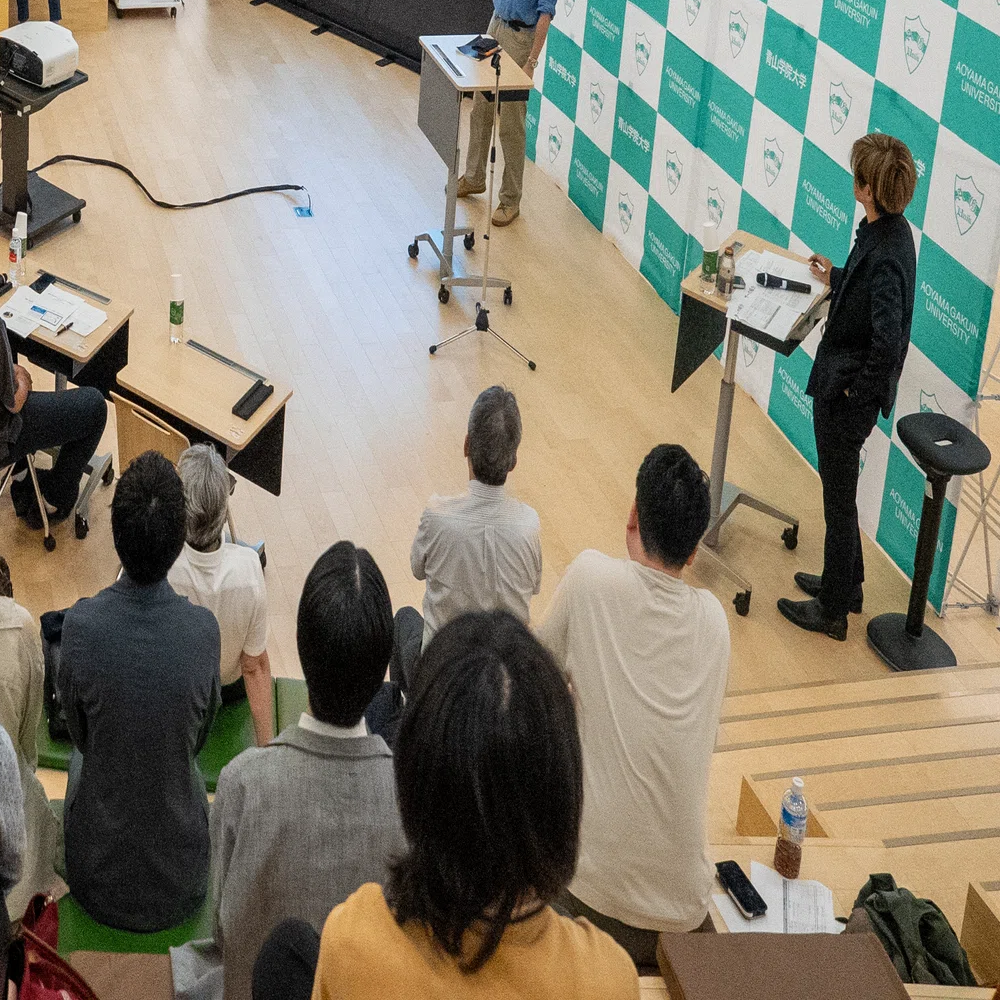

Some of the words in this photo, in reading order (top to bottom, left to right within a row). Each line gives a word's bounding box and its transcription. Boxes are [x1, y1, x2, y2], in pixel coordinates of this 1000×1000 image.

[666, 66, 683, 86] AOYAMA
[683, 80, 701, 102] GAKUIN
[766, 49, 807, 89] 青山学院大学
[955, 61, 987, 89] AOYAMA
[669, 79, 696, 109] UNIVERSITY
[961, 79, 1000, 115] UNIVERSIT
[618, 116, 650, 153] 青山学院大学
[708, 100, 727, 120] AOYAMA
[726, 114, 745, 136] GAKUIN
[711, 113, 739, 142] UNIVERSITY
[802, 179, 825, 204] AOYAMA
[825, 198, 849, 225] GAKUIN
[805, 195, 841, 231] UNIVERSITY
[920, 281, 949, 311] AOYAMA
[949, 306, 979, 339] GAKUIN
[925, 299, 969, 344] UNIVERSITY
[778, 366, 801, 395] AOYAMA
[890, 488, 916, 520] AOYAMA
